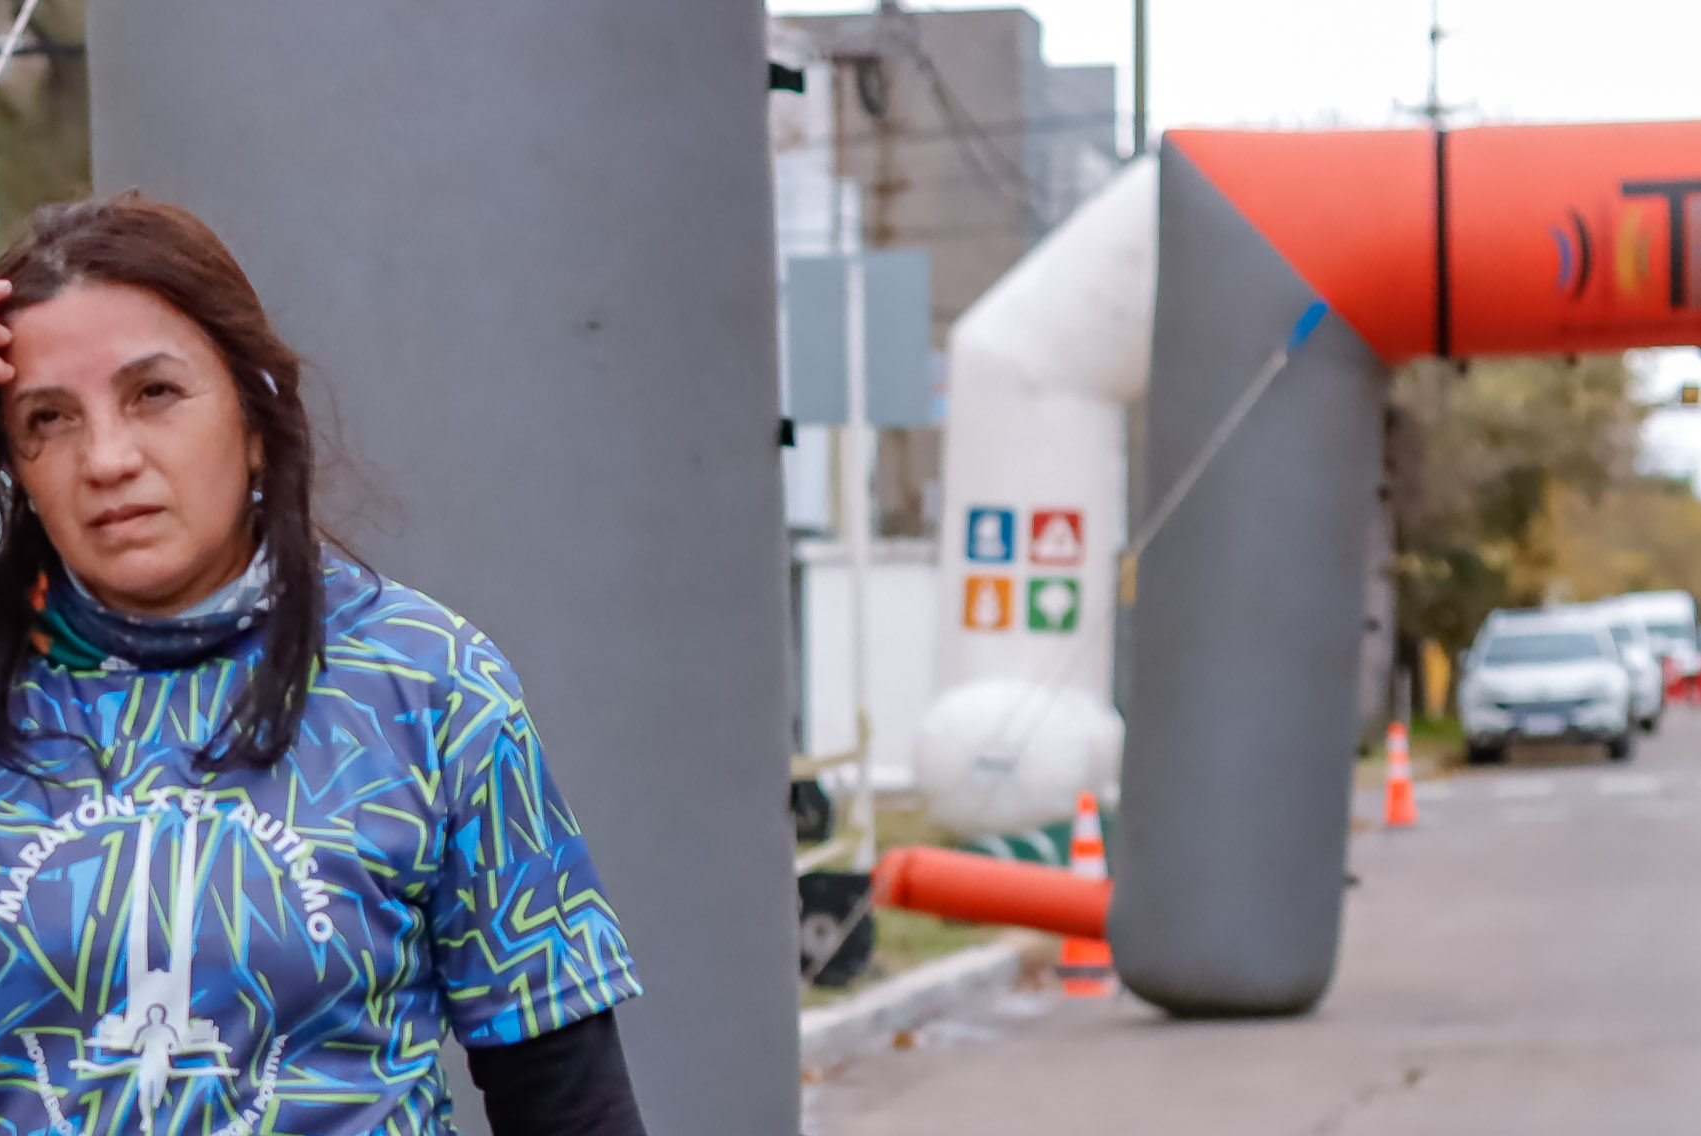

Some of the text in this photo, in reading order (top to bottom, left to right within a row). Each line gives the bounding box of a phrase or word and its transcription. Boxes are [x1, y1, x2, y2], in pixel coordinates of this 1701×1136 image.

[147, 787, 172, 813] X
[181, 787, 218, 817] EL
[226, 803, 334, 943] AUTISMO
